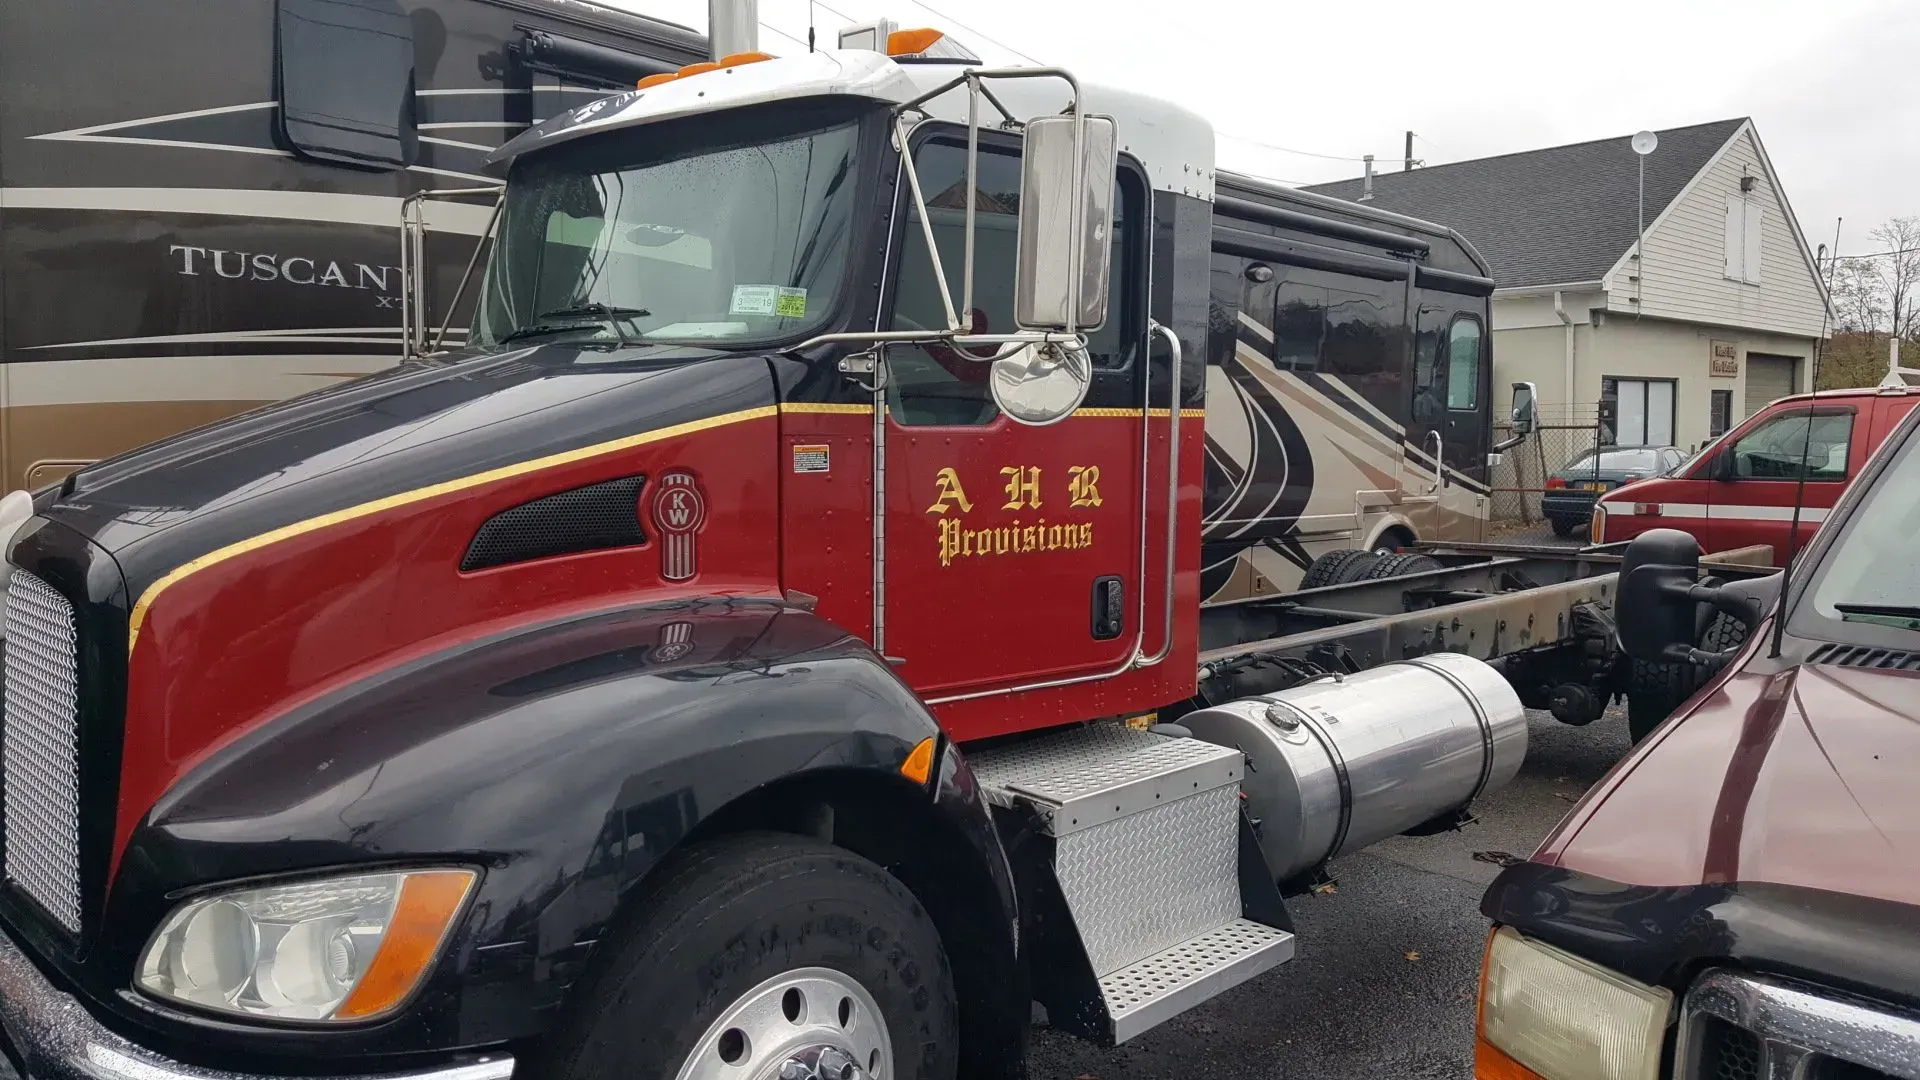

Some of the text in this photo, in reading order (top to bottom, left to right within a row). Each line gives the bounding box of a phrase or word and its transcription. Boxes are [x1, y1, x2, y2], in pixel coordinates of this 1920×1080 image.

[737, 297, 744, 306] 3
[763, 298, 772, 307] 19
[925, 465, 1103, 514] A H R
[938, 518, 1093, 567] Provisions
